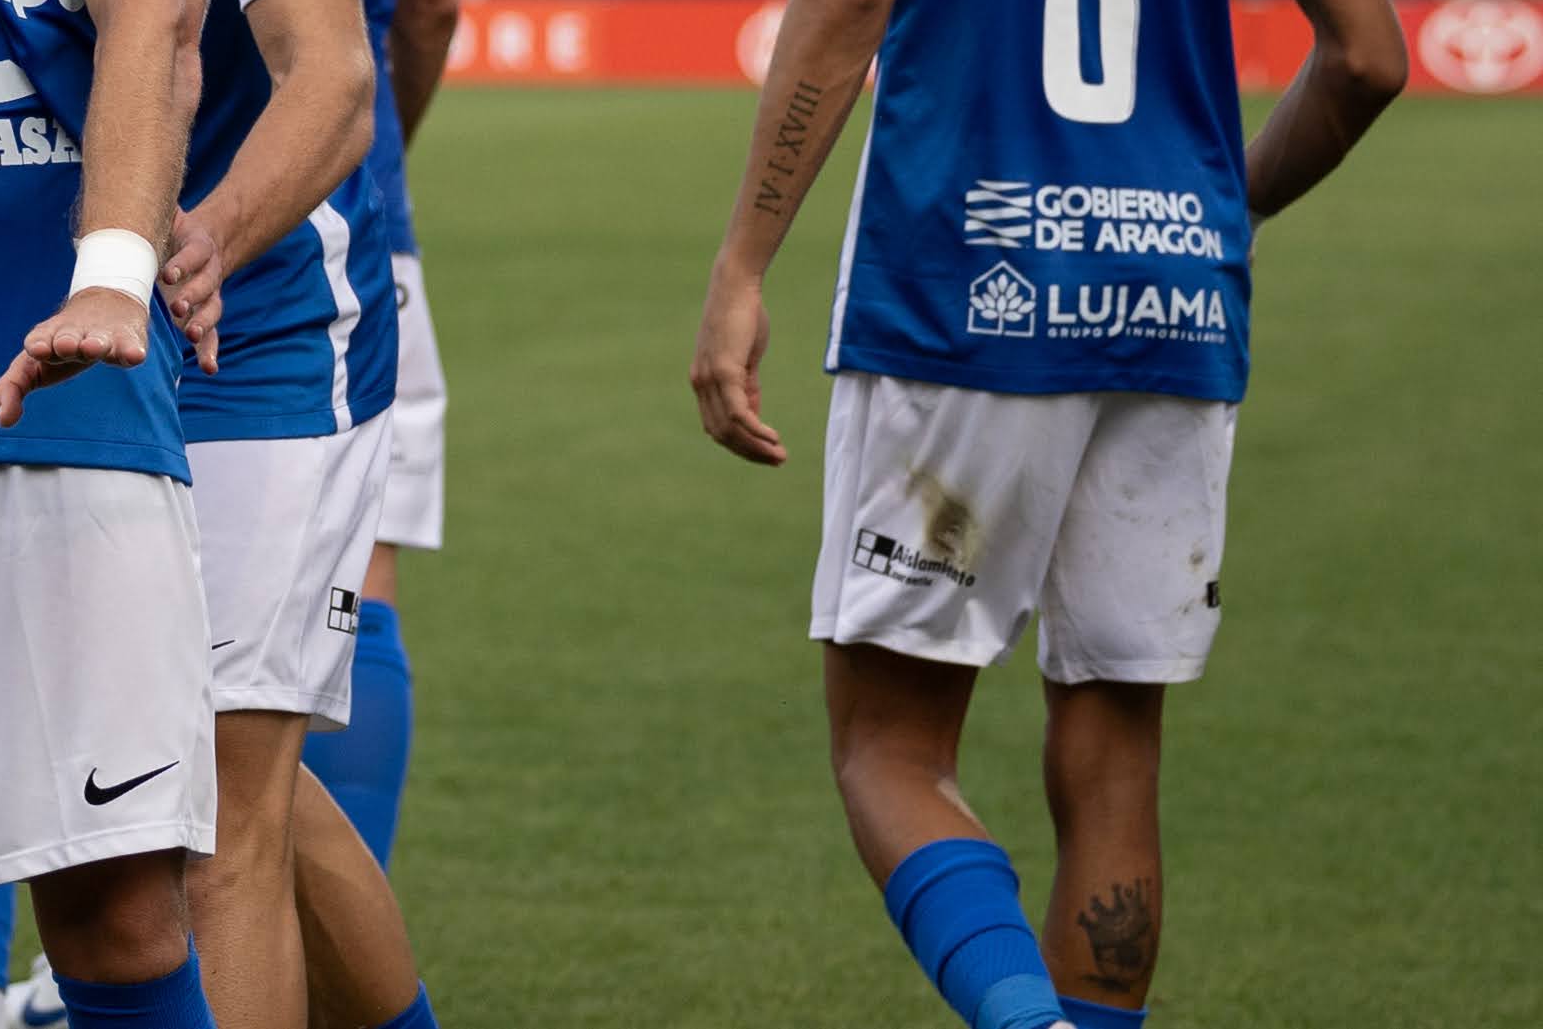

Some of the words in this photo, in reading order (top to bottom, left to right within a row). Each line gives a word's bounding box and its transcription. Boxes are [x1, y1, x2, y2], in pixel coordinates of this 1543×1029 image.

[1035, 185, 1203, 223] GOBIERNO
[1035, 219, 1084, 250] DE
[1094, 222, 1224, 260] ARAGON
[1048, 284, 1226, 337] LUJAMA
[1047, 326, 1103, 339] GRUPO
